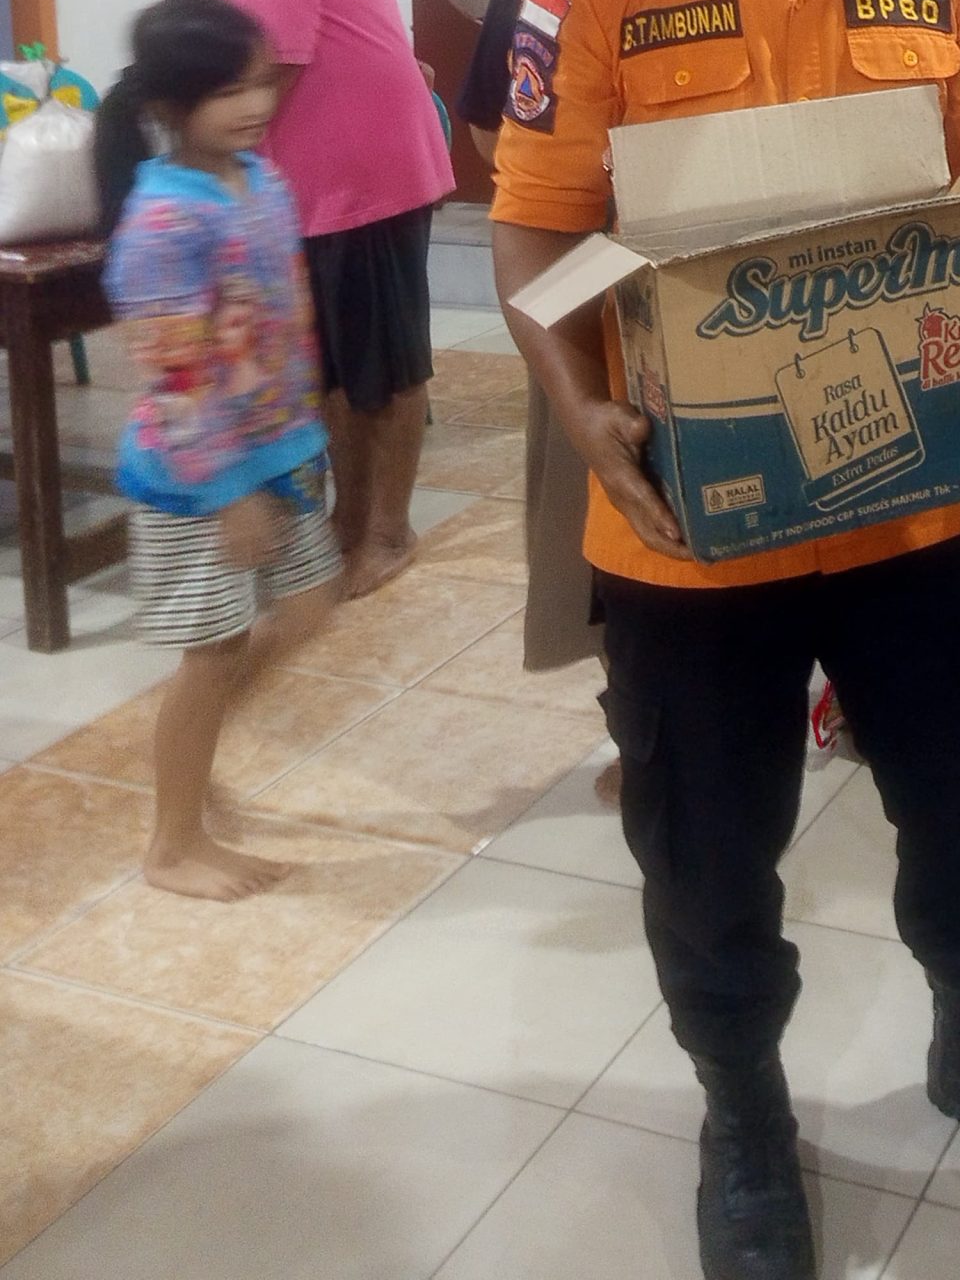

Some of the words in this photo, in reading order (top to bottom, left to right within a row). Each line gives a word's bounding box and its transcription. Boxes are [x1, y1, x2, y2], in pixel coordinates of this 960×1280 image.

[789, 248, 814, 269] mi
[817, 238, 877, 262] instan
[823, 374, 863, 406] Rasa
[811, 389, 889, 444] Kaldu
[826, 412, 900, 466] Ayam
[832, 464, 864, 487] Extra
[866, 445, 899, 469] Pedas
[727, 483, 760, 498] HALAL
[771, 529, 784, 540] PT
[857, 497, 890, 516] SUKSES
[891, 490, 931, 508] MAKMUR
[934, 484, 951, 496] Tbk
